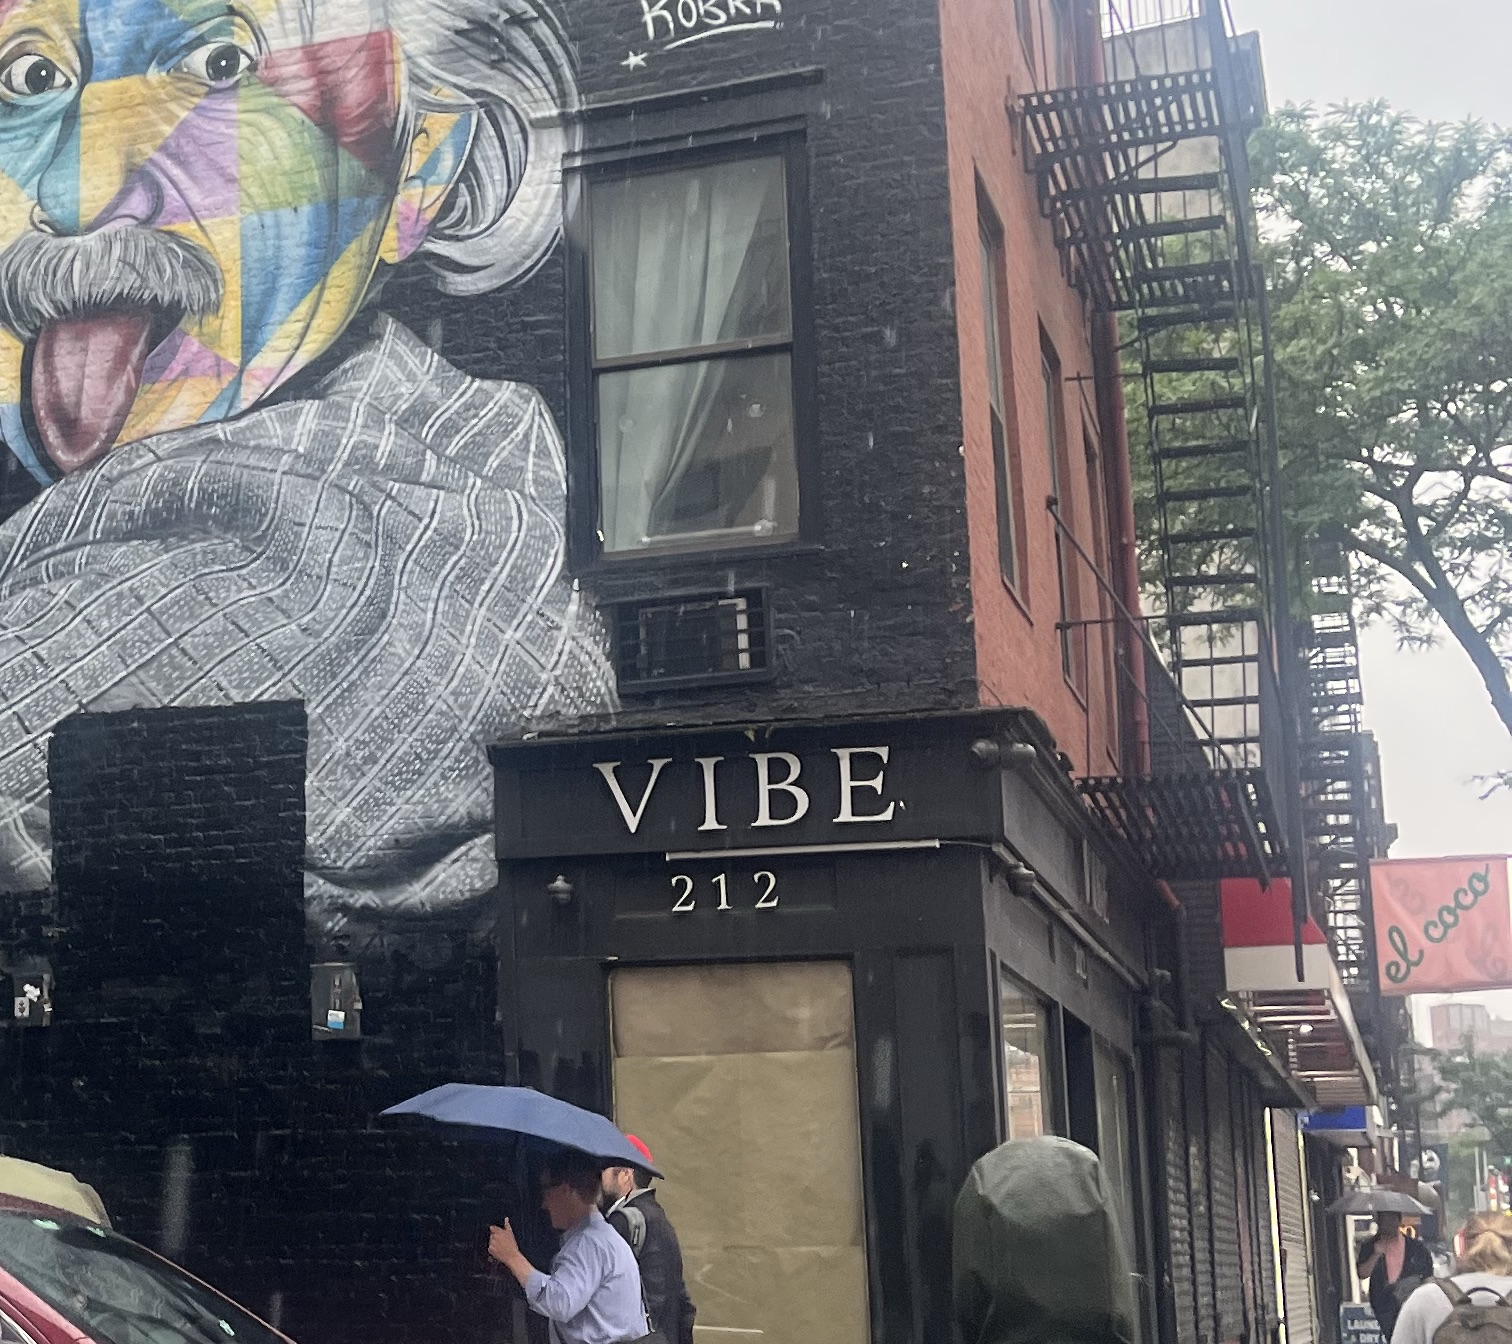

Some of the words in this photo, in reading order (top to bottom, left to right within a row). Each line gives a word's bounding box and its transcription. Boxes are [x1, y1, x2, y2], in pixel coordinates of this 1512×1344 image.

[592, 745, 896, 835] VIBE
[670, 870, 780, 913] 212
[1385, 924, 1425, 984] el
[1423, 862, 1490, 944] coco
